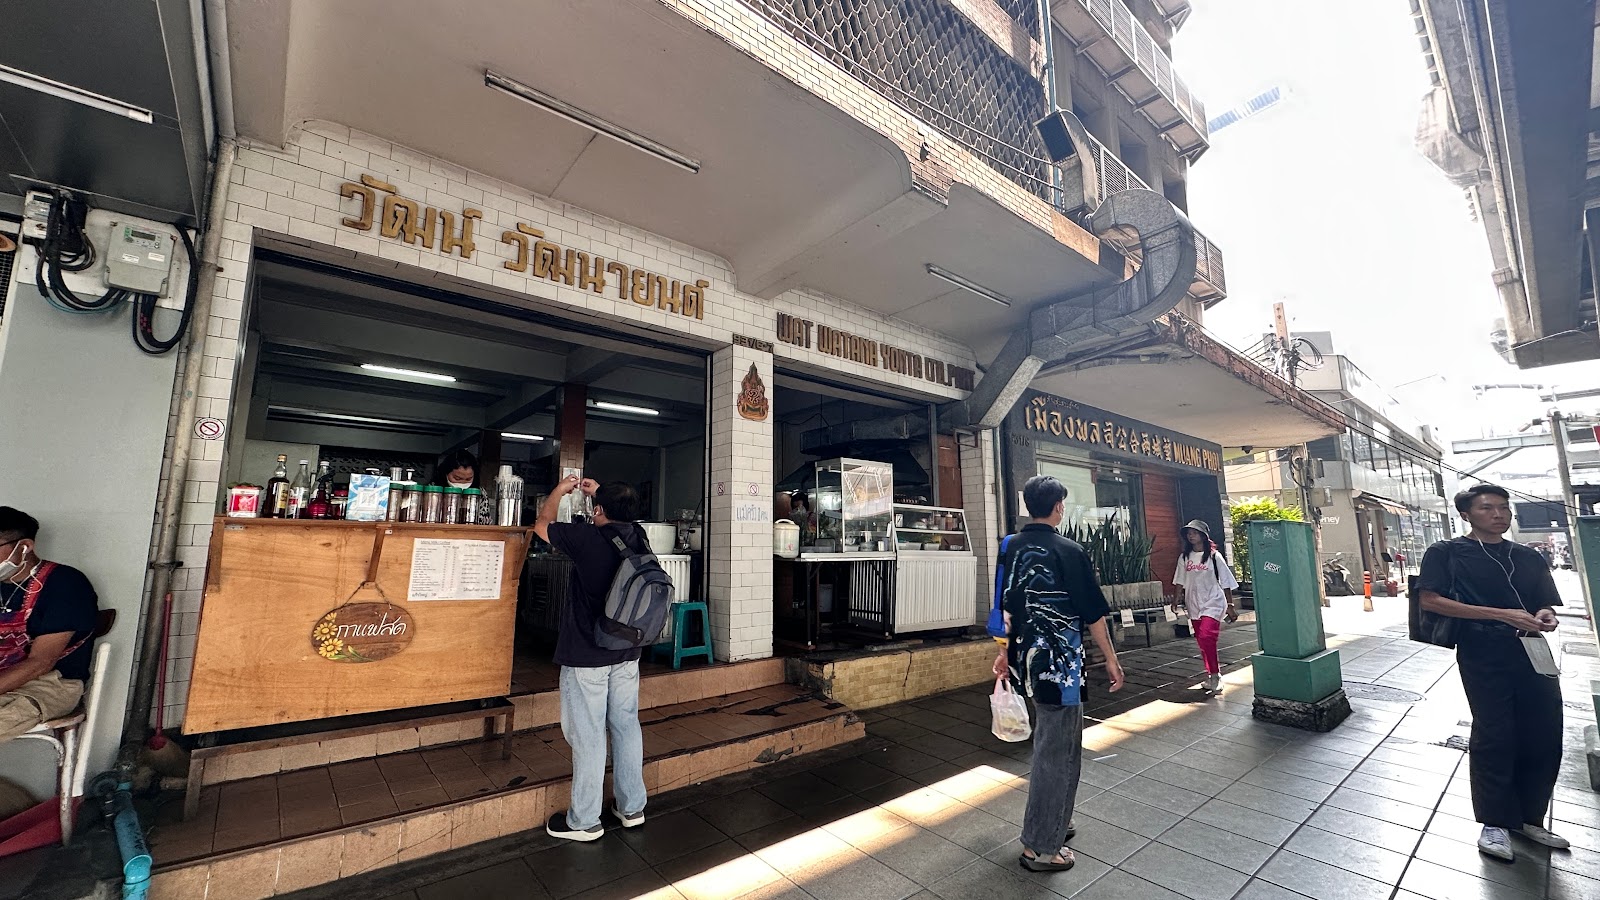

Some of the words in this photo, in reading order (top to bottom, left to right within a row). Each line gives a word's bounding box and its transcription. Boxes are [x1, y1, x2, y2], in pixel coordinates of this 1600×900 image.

[340, 174, 482, 259] วัฒน์
[502, 223, 709, 321] วัฒนายนต์
[777, 312, 813, 348] WAT
[817, 324, 878, 367] WATANA
[880, 343, 923, 379] YONTA
[1025, 396, 1101, 444] เมืองพล
[1173, 441, 1201, 468] MUANG
[1202, 448, 1223, 473] PHOL
[336, 612, 407, 638] กาแฟสด
